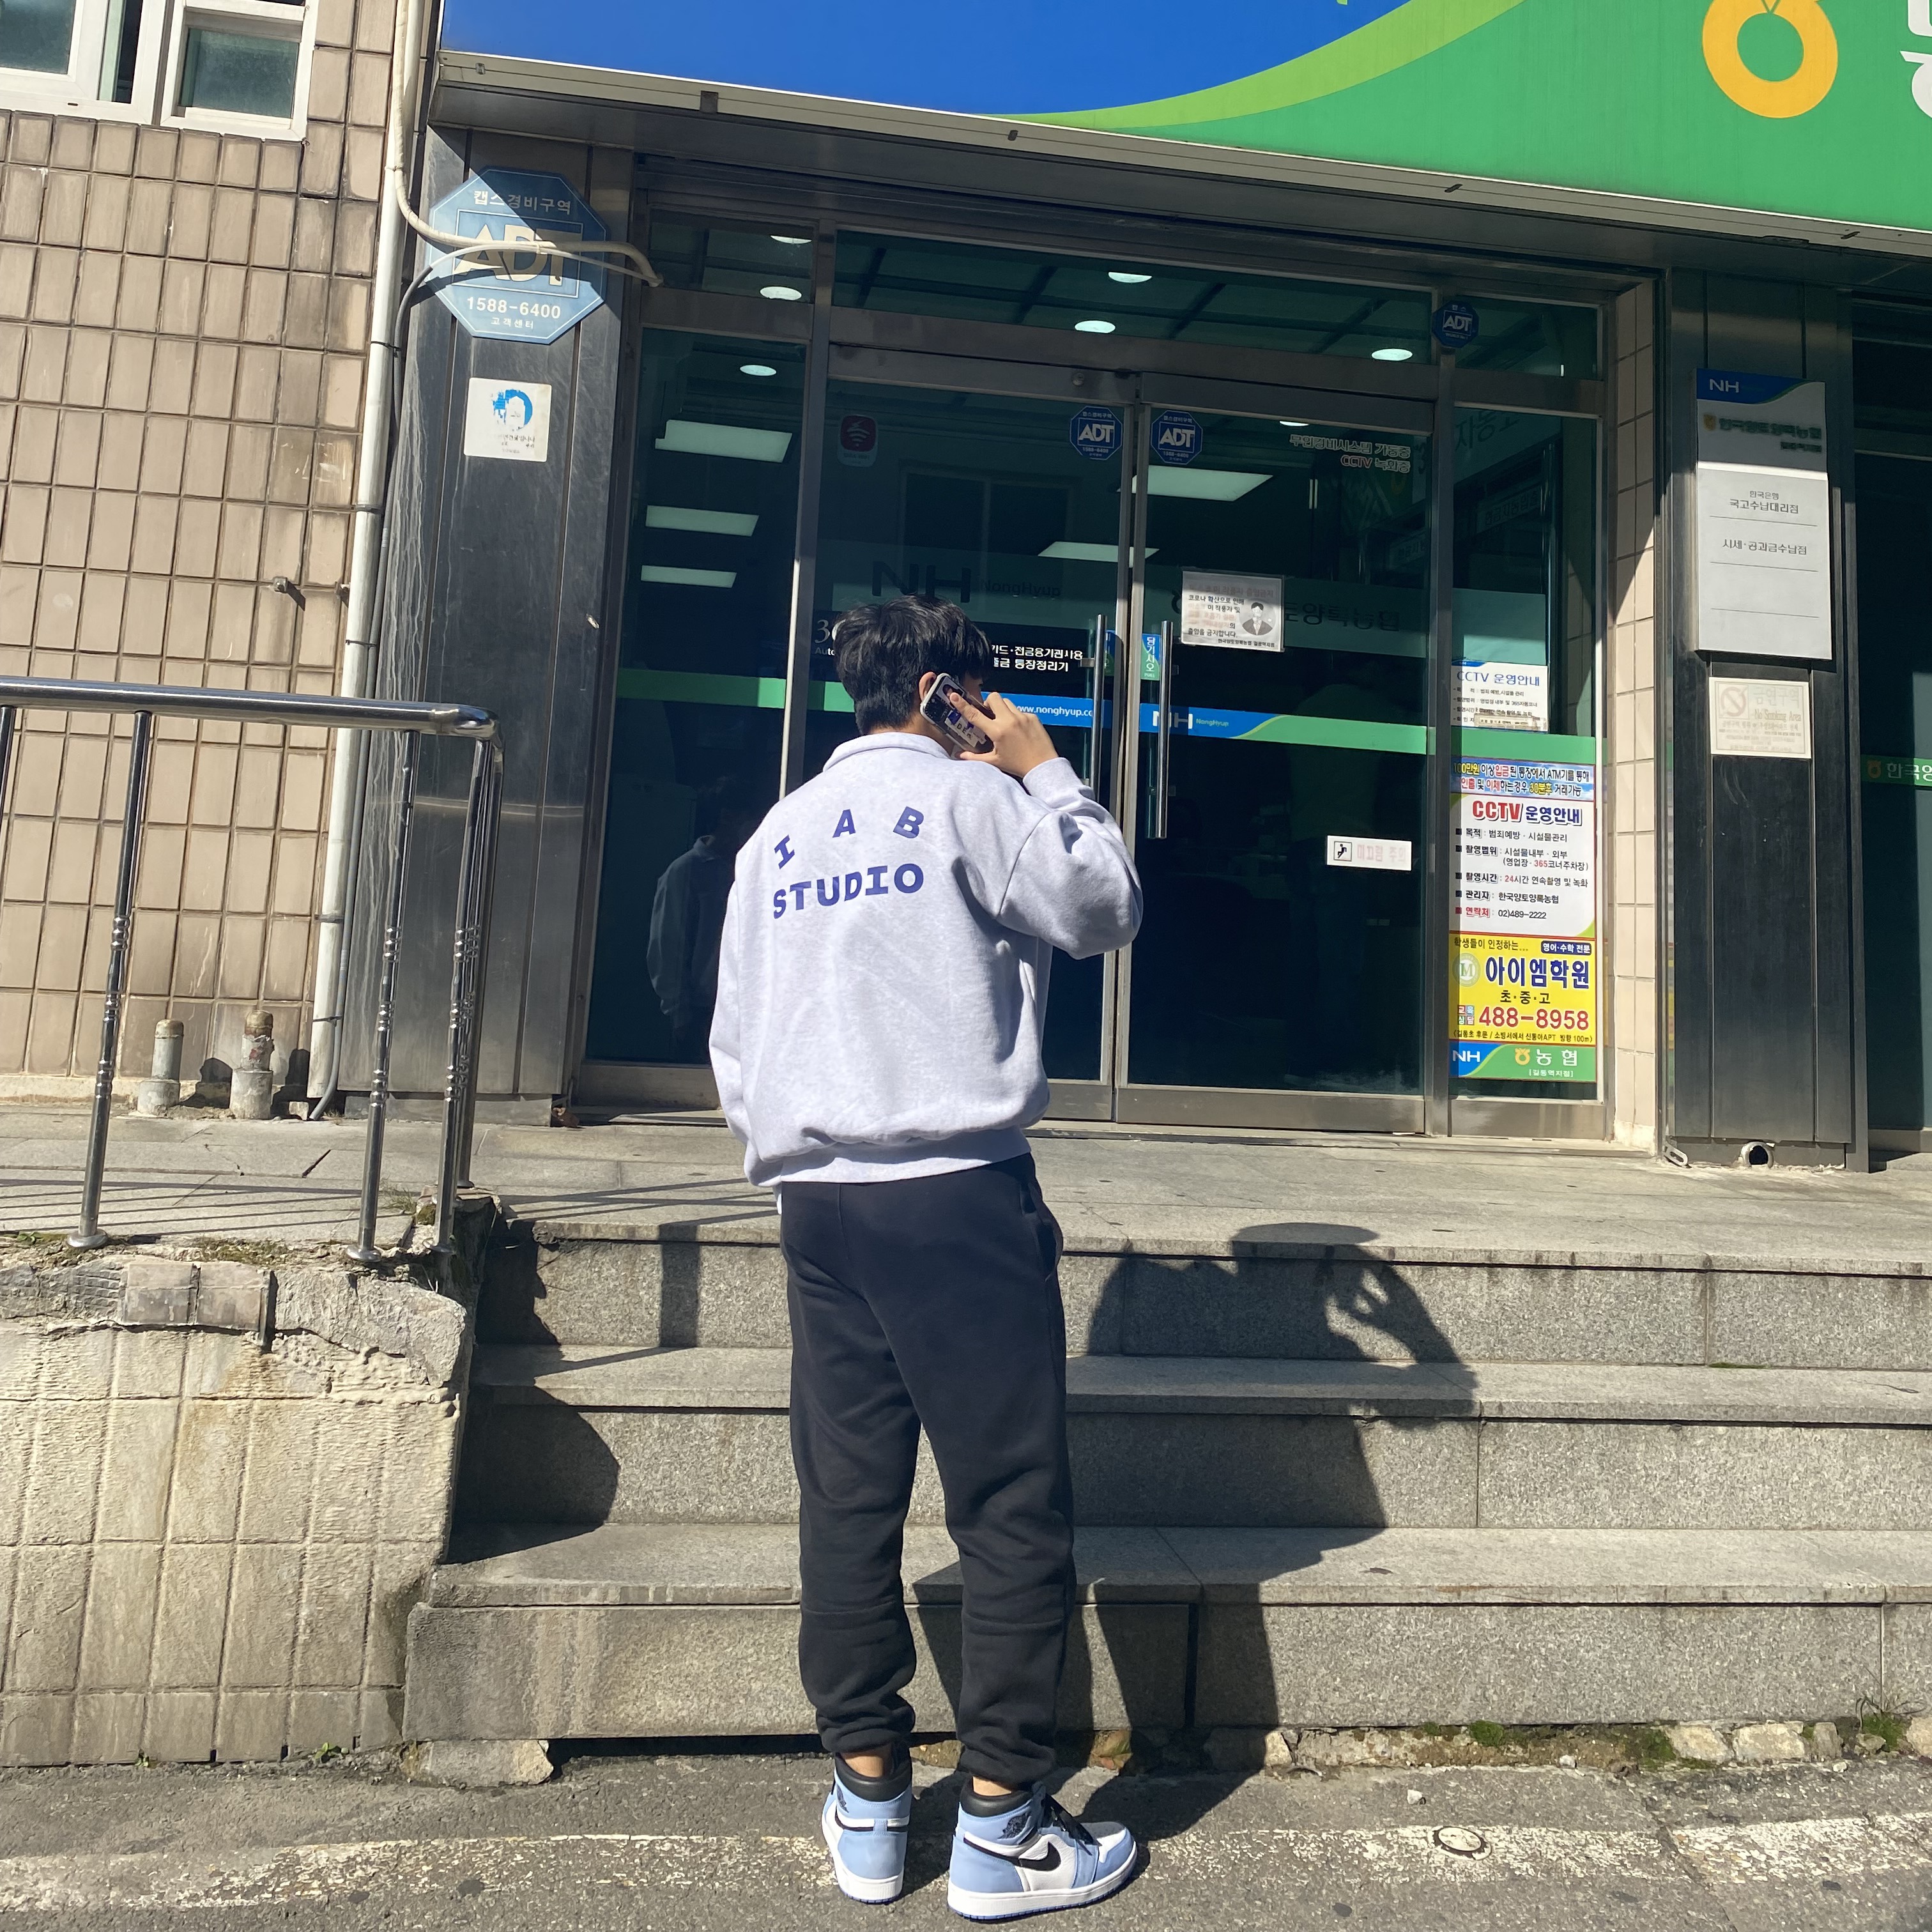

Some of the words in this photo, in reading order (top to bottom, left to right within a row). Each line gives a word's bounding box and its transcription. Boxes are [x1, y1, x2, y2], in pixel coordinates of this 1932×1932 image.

[473, 190, 571, 215] 캡스경비구역
[454, 224, 583, 286] ADT
[467, 297, 560, 319] 1588-6400
[491, 317, 533, 329] 고객센터
[1443, 315, 1473, 332] ADT
[1709, 379, 1739, 393] NH
[1078, 424, 1114, 443] ADT
[1160, 428, 1195, 448] ADT
[1289, 434, 1372, 454] 무인경비시스템
[1374, 443, 1411, 458] 가동중
[1340, 455, 1372, 469] CCTV
[1374, 457, 1411, 473] 녹화중
[1749, 491, 1779, 500] 한국은행
[1729, 499, 1798, 514] 국고수납대리점
[1722, 539, 1807, 555] 시세·공과금수납점
[871, 561, 972, 603] NH
[983, 579, 1062, 597] NongHyup
[1146, 636, 1156, 672] 당기시오
[1015, 659, 1069, 671] 통장정리기
[1457, 671, 1489, 682] CCTV
[1494, 673, 1540, 686] 운영안내
[1196, 718, 1230, 728] NongHyup
[1754, 709, 1763, 720] No
[1789, 710, 1802, 722] Area
[1453, 762, 1480, 774] 100만원
[1481, 765, 1517, 778] 이상입금된
[1519, 767, 1545, 779] 통장에서
[1547, 769, 1574, 781] ATM기를
[1576, 770, 1590, 783] 통해
[1461, 778, 1475, 790] 인출
[1477, 779, 1484, 790] 및
[1529, 783, 1552, 796] 30분후
[1554, 784, 1582, 797] 거래가능
[1472, 800, 1522, 822] CCTV
[1525, 806, 1582, 825] 운영안내
[1489, 829, 1521, 839] 범죄예방
[1528, 832, 1567, 842] 시설물관리
[1505, 847, 1544, 857] 시설물내부
[1552, 850, 1568, 859] 외부
[1505, 875, 1529, 884] 24시간
[1563, 877, 1571, 887] 및
[1572, 877, 1588, 887] 녹화
[774, 863, 924, 919] STUDIO
[1498, 909, 1547, 920] 02)489-2222
[1454, 938, 1485, 949] 학생들이
[1543, 943, 1575, 954] 영어·수학
[1576, 945, 1591, 954] 전문
[1486, 956, 1590, 989] 아이엠학원
[1500, 990, 1551, 1004] 초·중·고
[1479, 1006, 1590, 1031] 488-8958
[1452, 1050, 1480, 1062] NH
[1536, 1049, 1577, 1066] 농협
